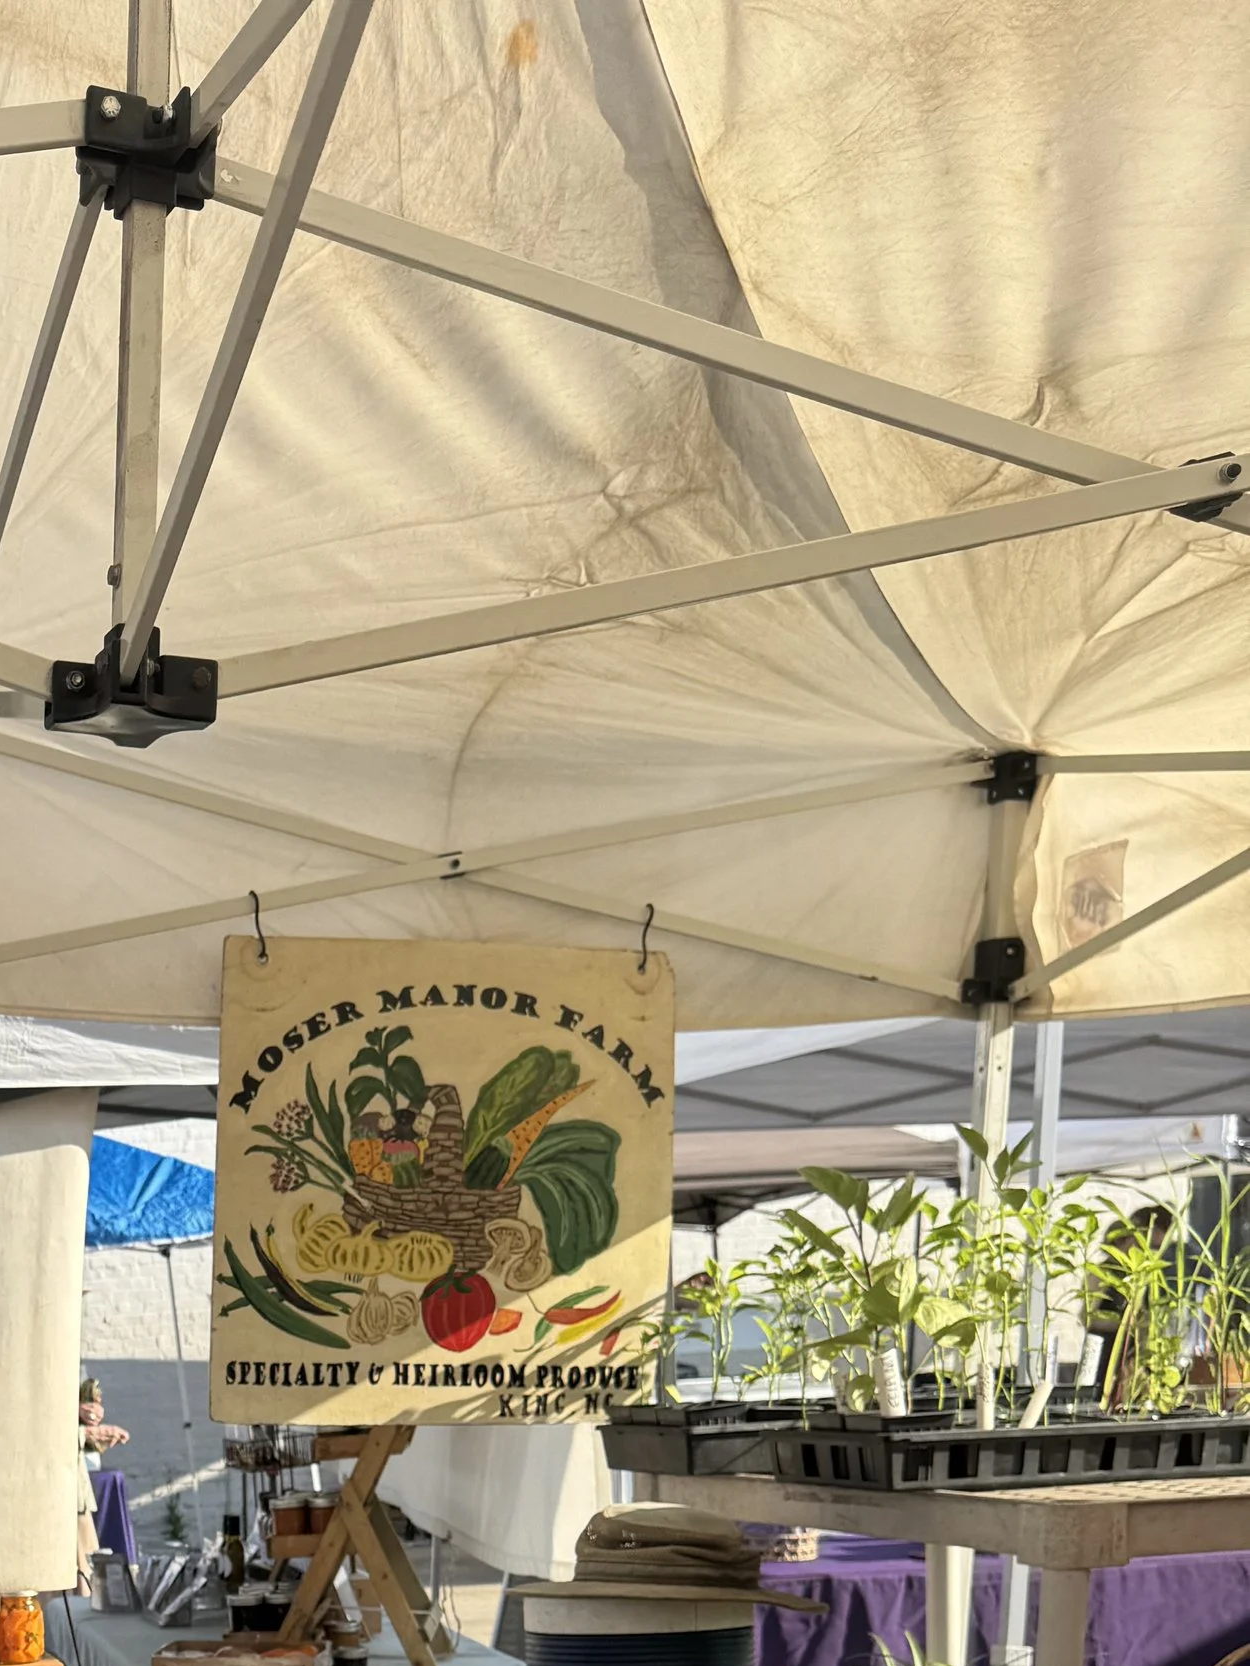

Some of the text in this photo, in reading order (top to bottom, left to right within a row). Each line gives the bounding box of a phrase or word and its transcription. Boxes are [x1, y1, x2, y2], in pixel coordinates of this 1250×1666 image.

[229, 984, 666, 1115] MOSER MANOR FARM
[225, 1361, 360, 1387] SPECIALTY
[392, 1362, 526, 1389] HEIRLOOM
[535, 1364, 639, 1390] PRODUCE
